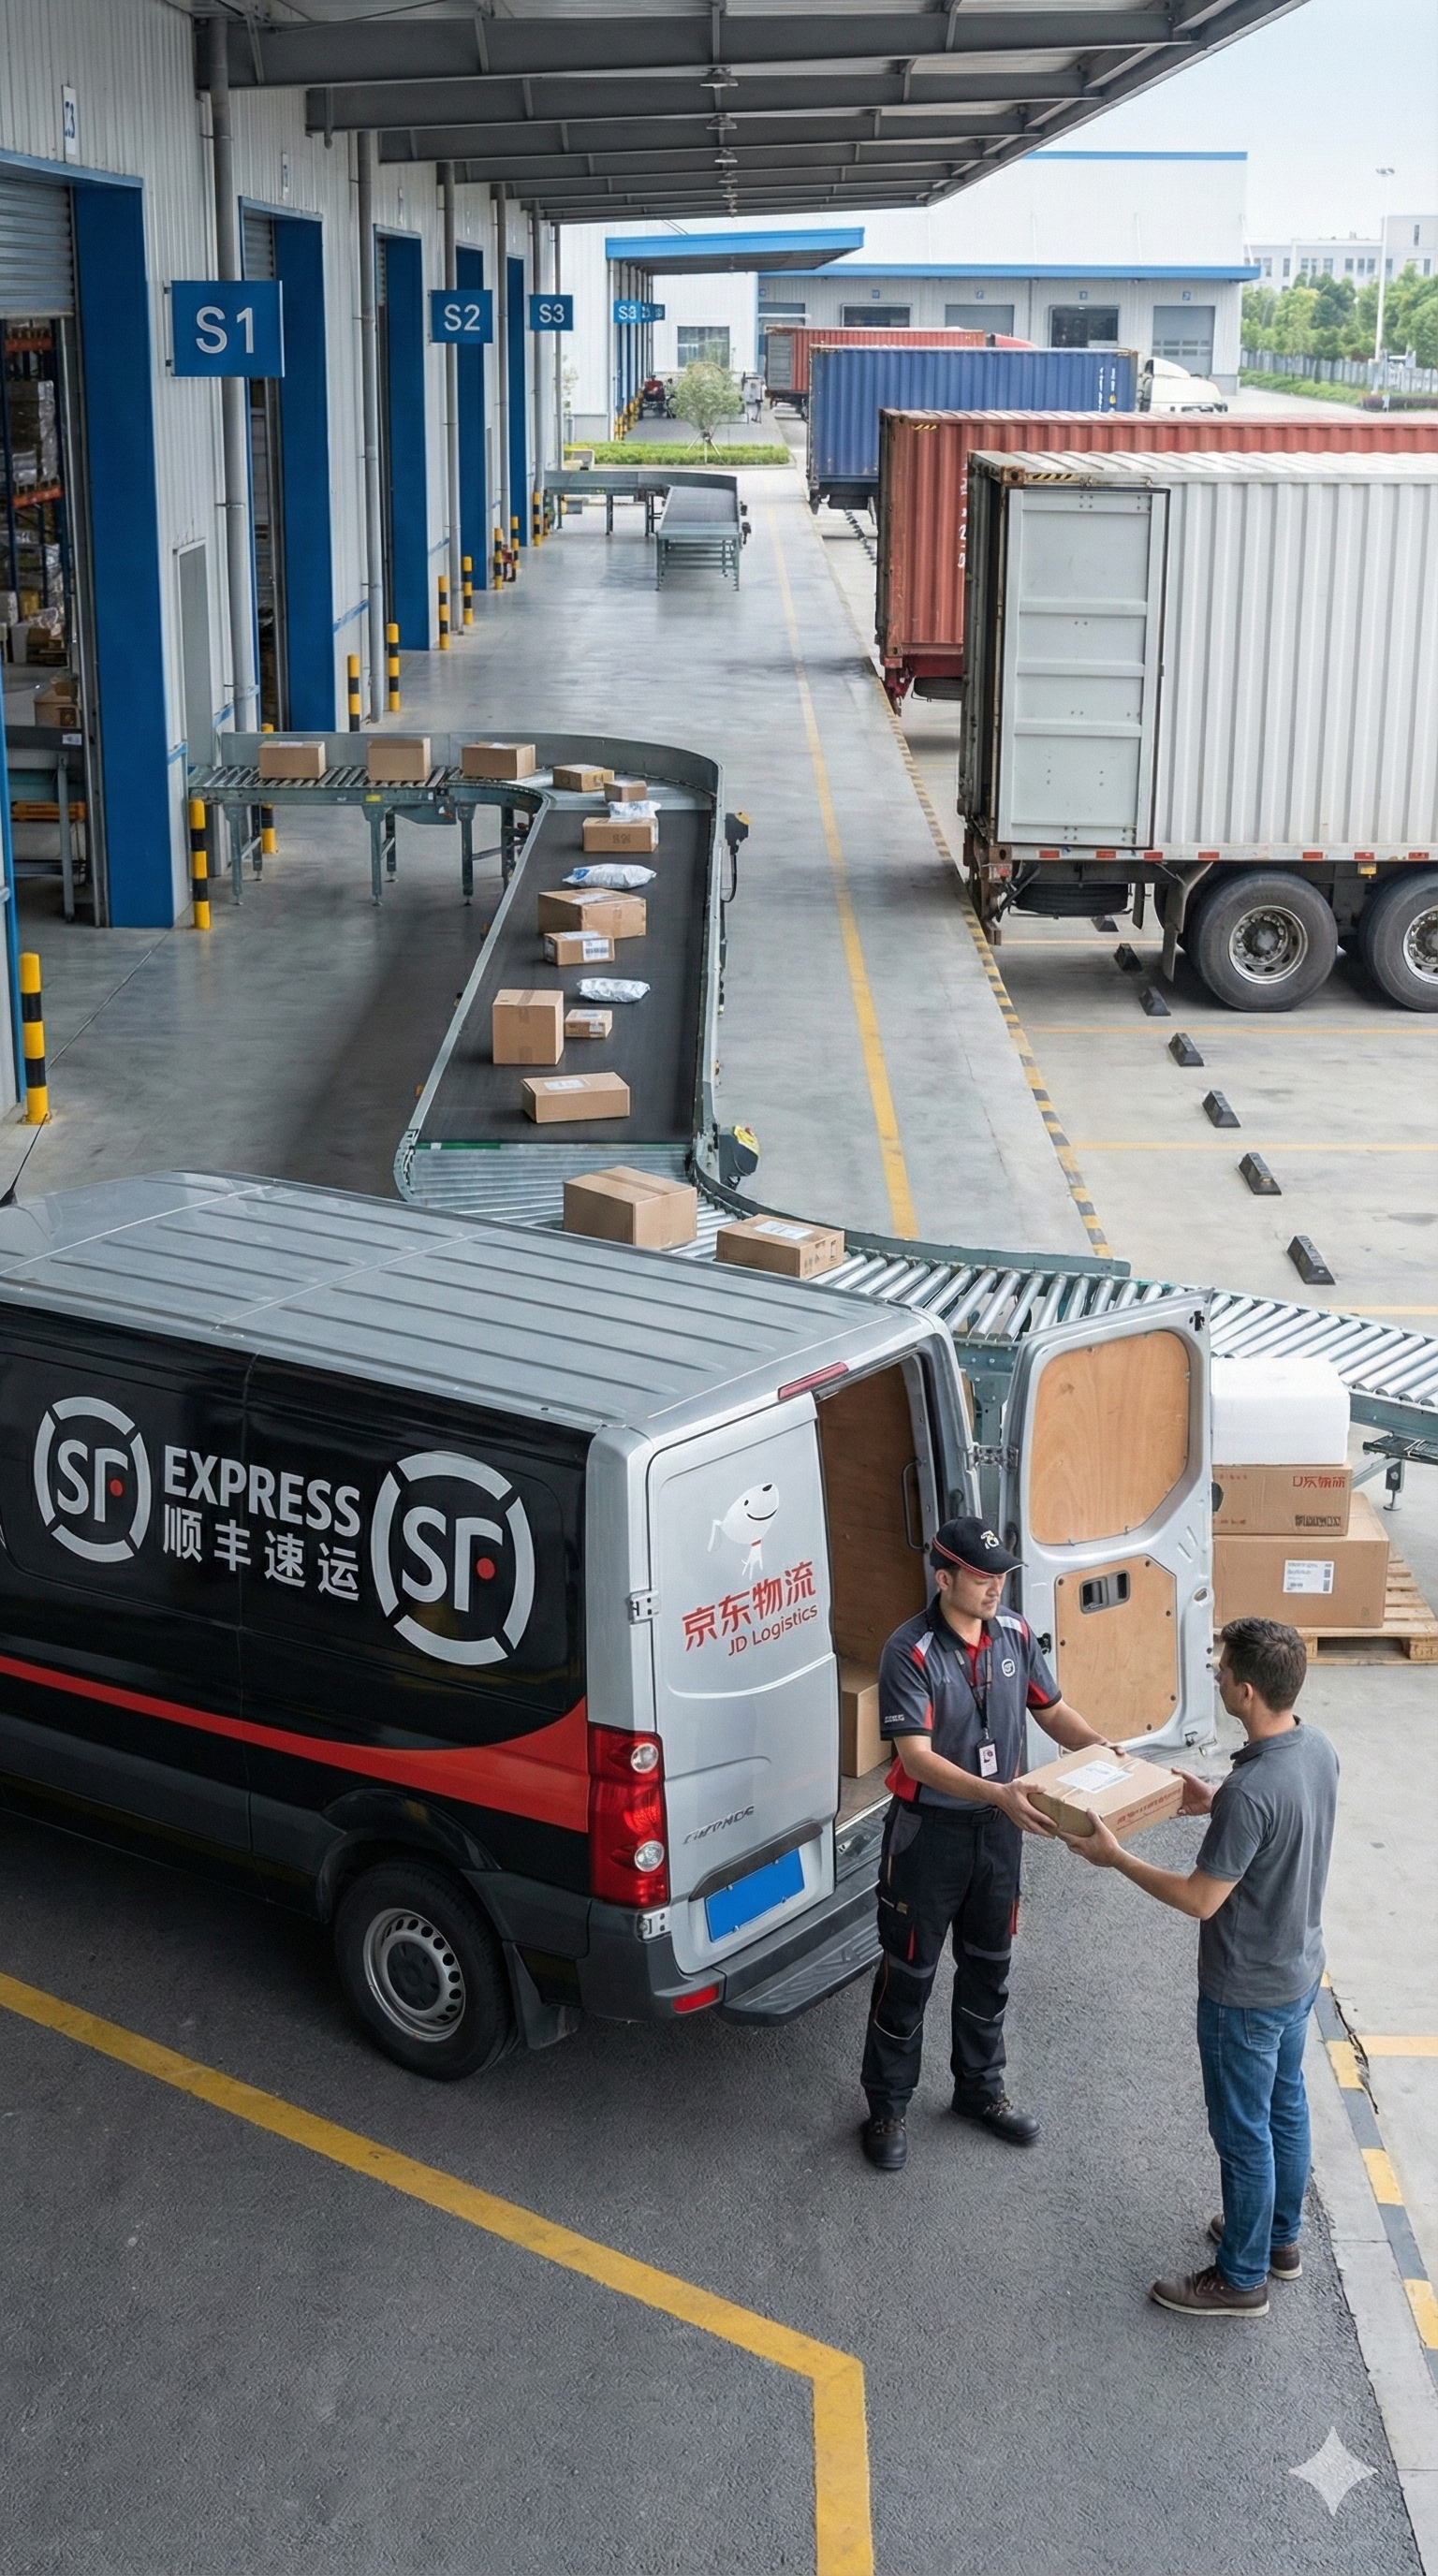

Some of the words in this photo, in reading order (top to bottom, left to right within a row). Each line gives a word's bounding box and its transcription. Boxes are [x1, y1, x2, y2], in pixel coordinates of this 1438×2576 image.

[196, 306, 255, 354] S1
[444, 303, 480, 331] S2
[539, 303, 565, 323] S3
[57, 1439, 129, 1523] SF
[164, 1444, 360, 1537] EXPRESS
[163, 1503, 360, 1602] 顺丰速运
[402, 1505, 503, 1613] SF
[682, 1560, 816, 1651] 京东物流
[728, 1635, 748, 1656] JD
[752, 1604, 818, 1646] Logistics
